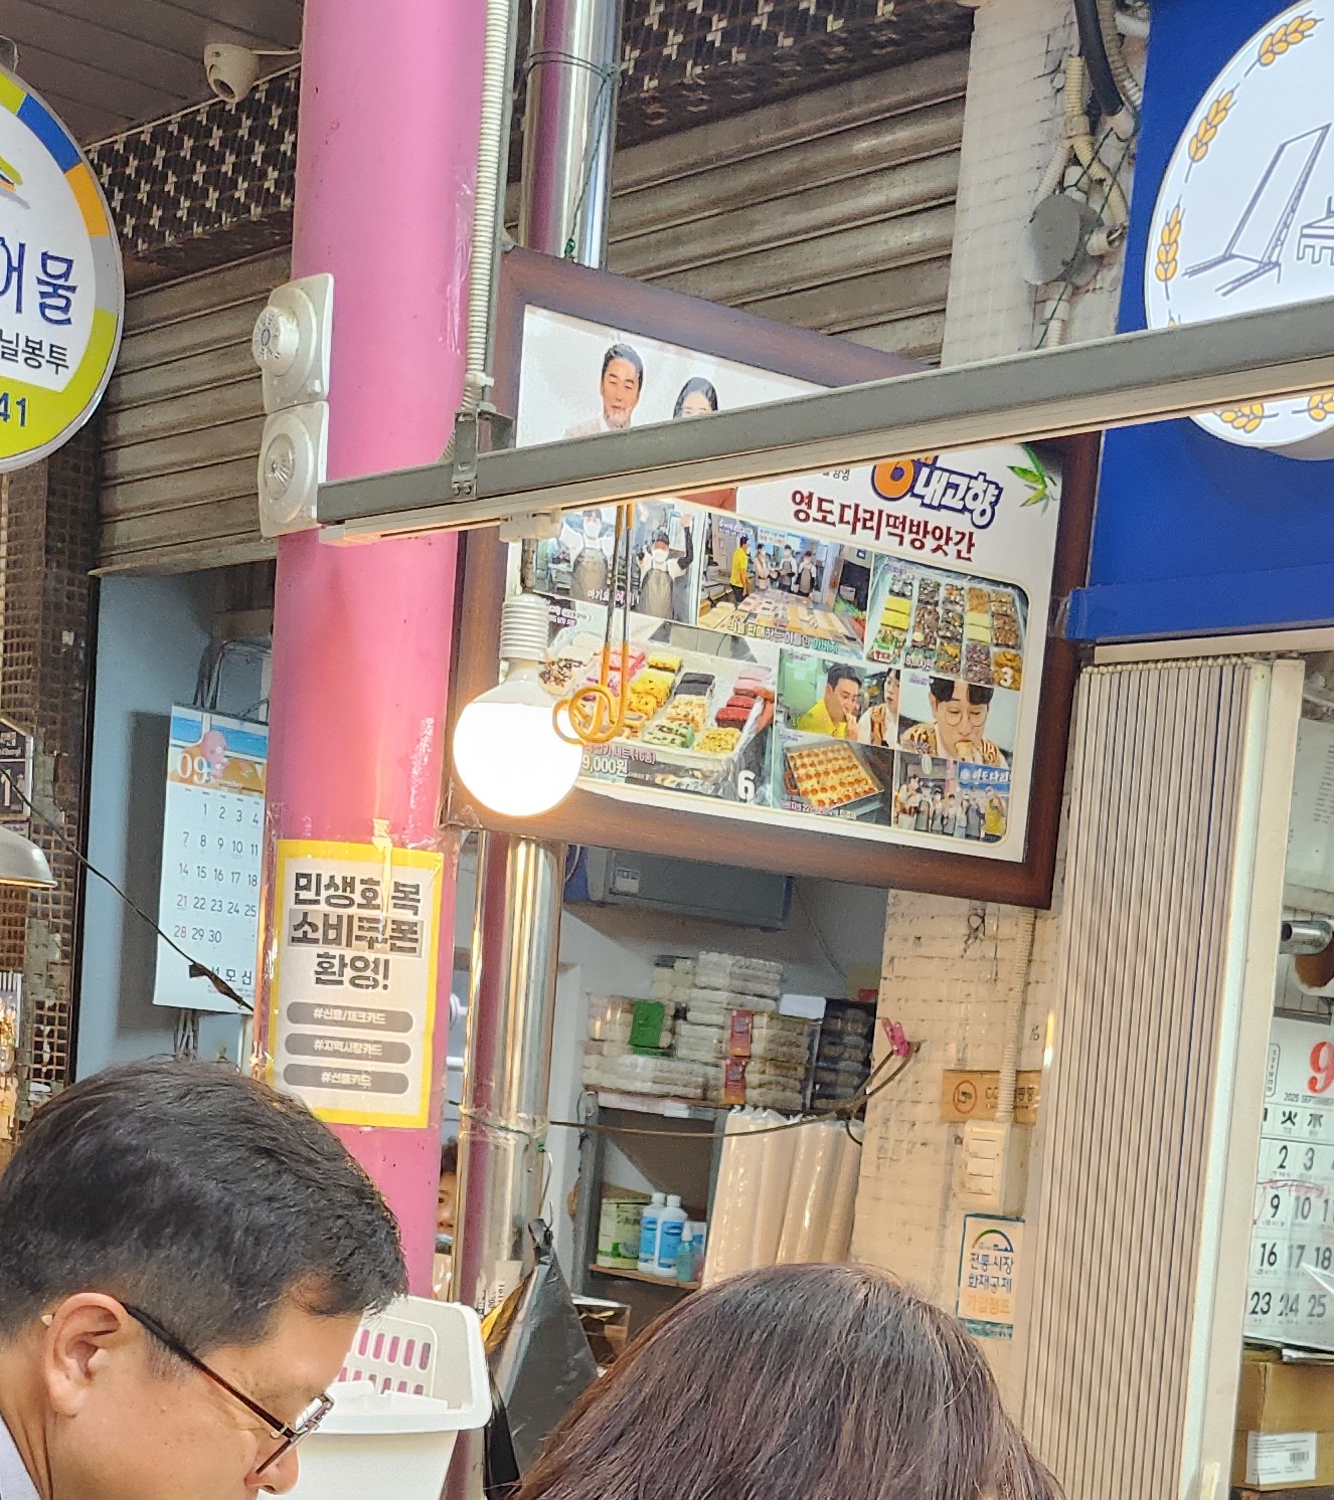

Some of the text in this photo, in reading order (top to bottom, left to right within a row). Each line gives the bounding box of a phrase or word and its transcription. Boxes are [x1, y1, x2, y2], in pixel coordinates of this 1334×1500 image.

[914, 466, 1002, 529] 내고향
[791, 489, 976, 562] 영도다리떡방앗간
[1000, 666, 1014, 685] 3
[177, 753, 212, 784] 09
[737, 769, 756, 801] 6
[203, 803, 259, 825] 1 2 3 4
[183, 831, 258, 857] 7 8 9 10 11
[179, 862, 258, 887] 14 15 16 17 18
[177, 894, 257, 918] 21 22 23 24 25
[293, 871, 421, 917] 민생회복
[173, 925, 222, 944] 28 29 30
[290, 911, 419, 954] 소비쿠폰
[314, 951, 391, 991] 환영!
[1280, 1109, 1298, 1127] 火
[1276, 1144, 1289, 1170] 2
[1303, 1147, 1315, 1172] 3
[1270, 1194, 1281, 1219] 9
[1294, 1196, 1312, 1220] 10
[1259, 1242, 1278, 1267] 16
[1287, 1244, 1306, 1269] 17
[1314, 1246, 1332, 1270] 18
[1249, 1291, 1272, 1316] 23
[1277, 1293, 1300, 1317] 24
[1306, 1294, 1327, 1318] 25
